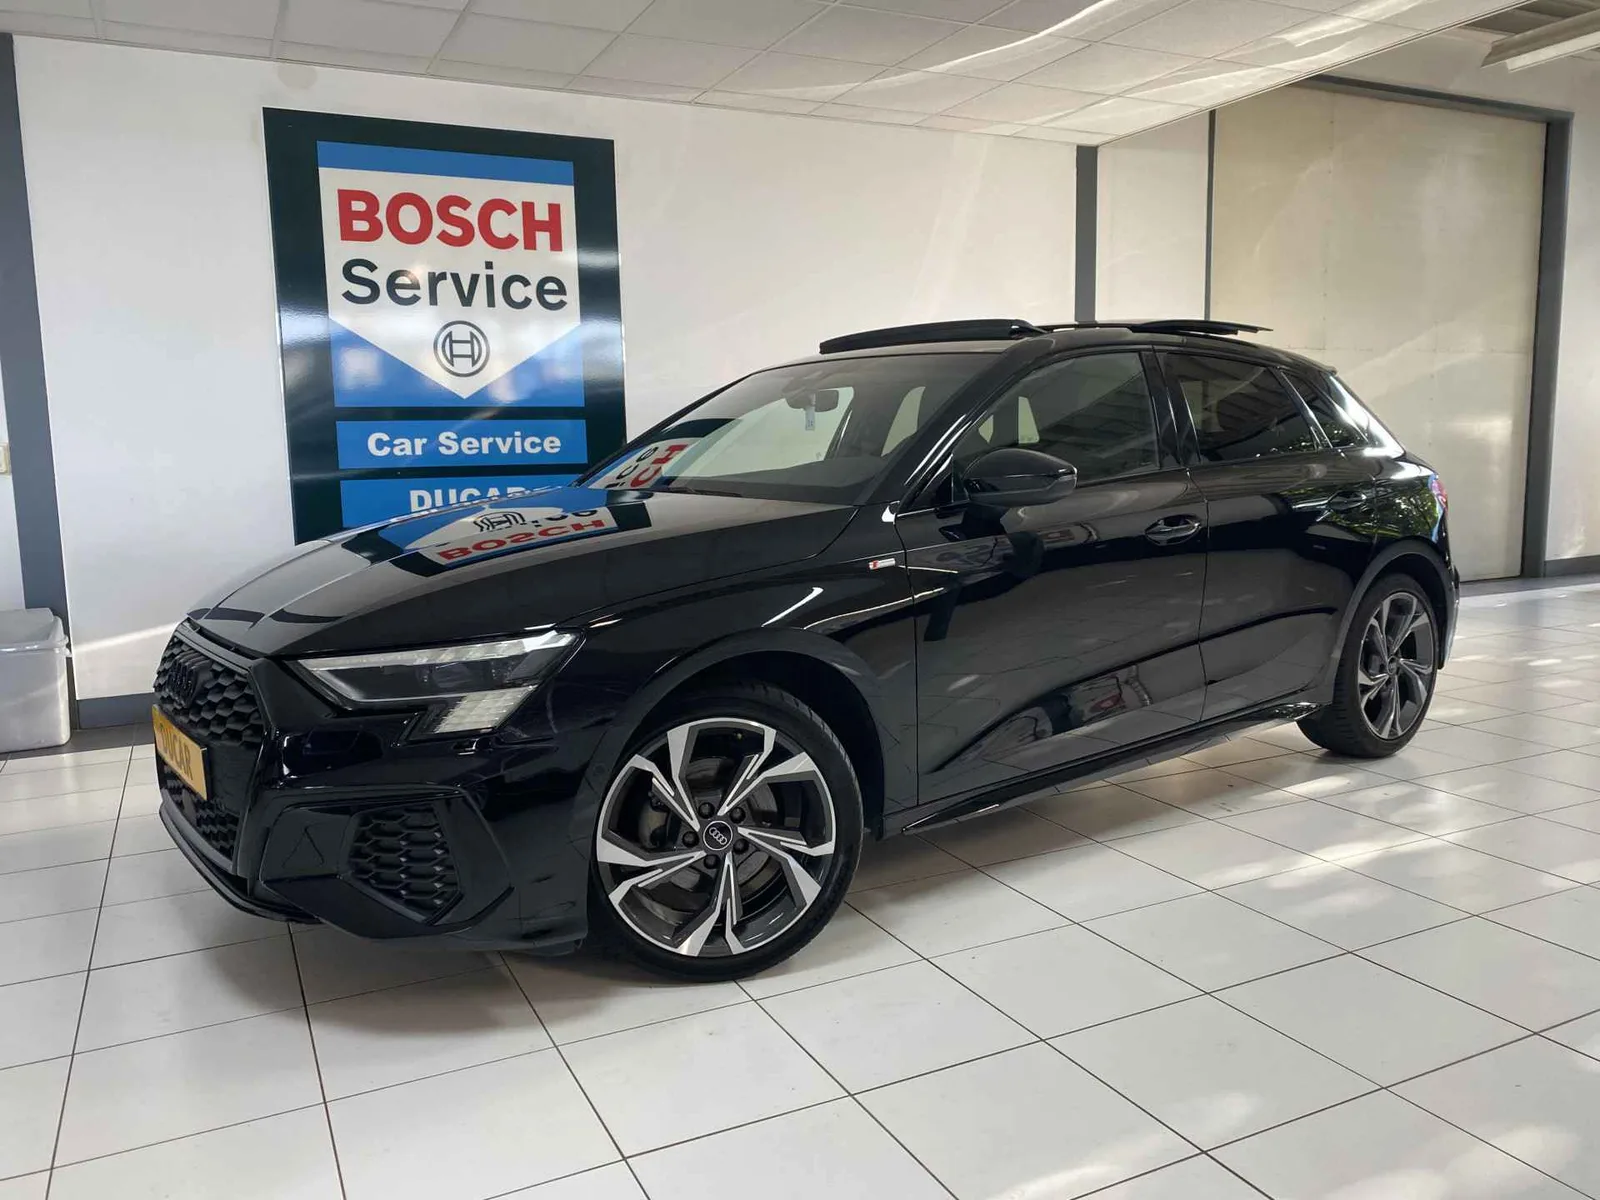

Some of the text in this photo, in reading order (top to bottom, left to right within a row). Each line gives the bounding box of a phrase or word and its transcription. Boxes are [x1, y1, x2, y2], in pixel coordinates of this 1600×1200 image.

[337, 188, 563, 252] BOSCH
[341, 258, 568, 311] Service
[367, 431, 562, 456] Car Service
